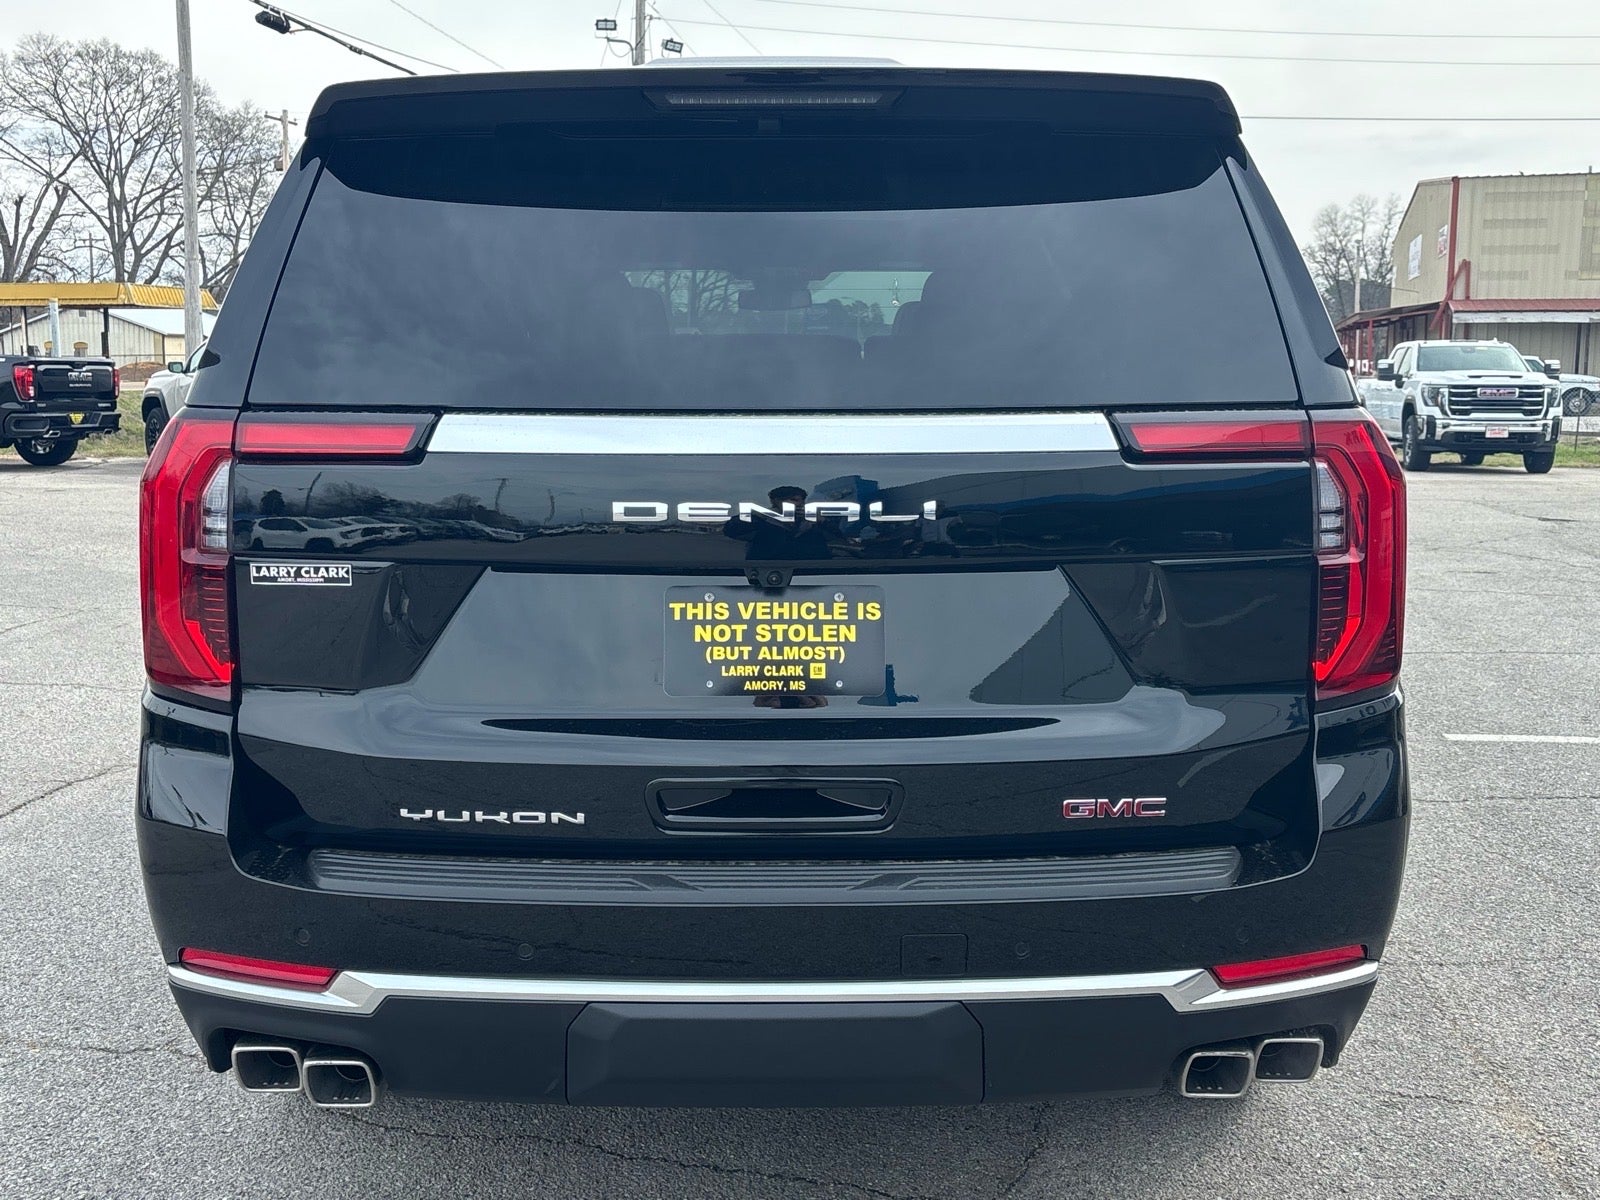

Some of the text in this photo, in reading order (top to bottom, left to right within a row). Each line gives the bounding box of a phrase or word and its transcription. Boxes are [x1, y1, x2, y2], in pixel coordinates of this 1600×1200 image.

[612, 501, 937, 522] DENALI
[252, 566, 349, 578] LARRY CLARK
[669, 602, 881, 620] THIS VEHICLE IS
[694, 624, 856, 642] NOT STOLEN
[705, 646, 845, 663] (BUT ALMOST)
[721, 665, 759, 677] LARRY
[764, 665, 804, 677] CLARK
[744, 680, 806, 691] AMORY, MS
[1063, 797, 1167, 818] GMC
[400, 809, 585, 825] YUKON
